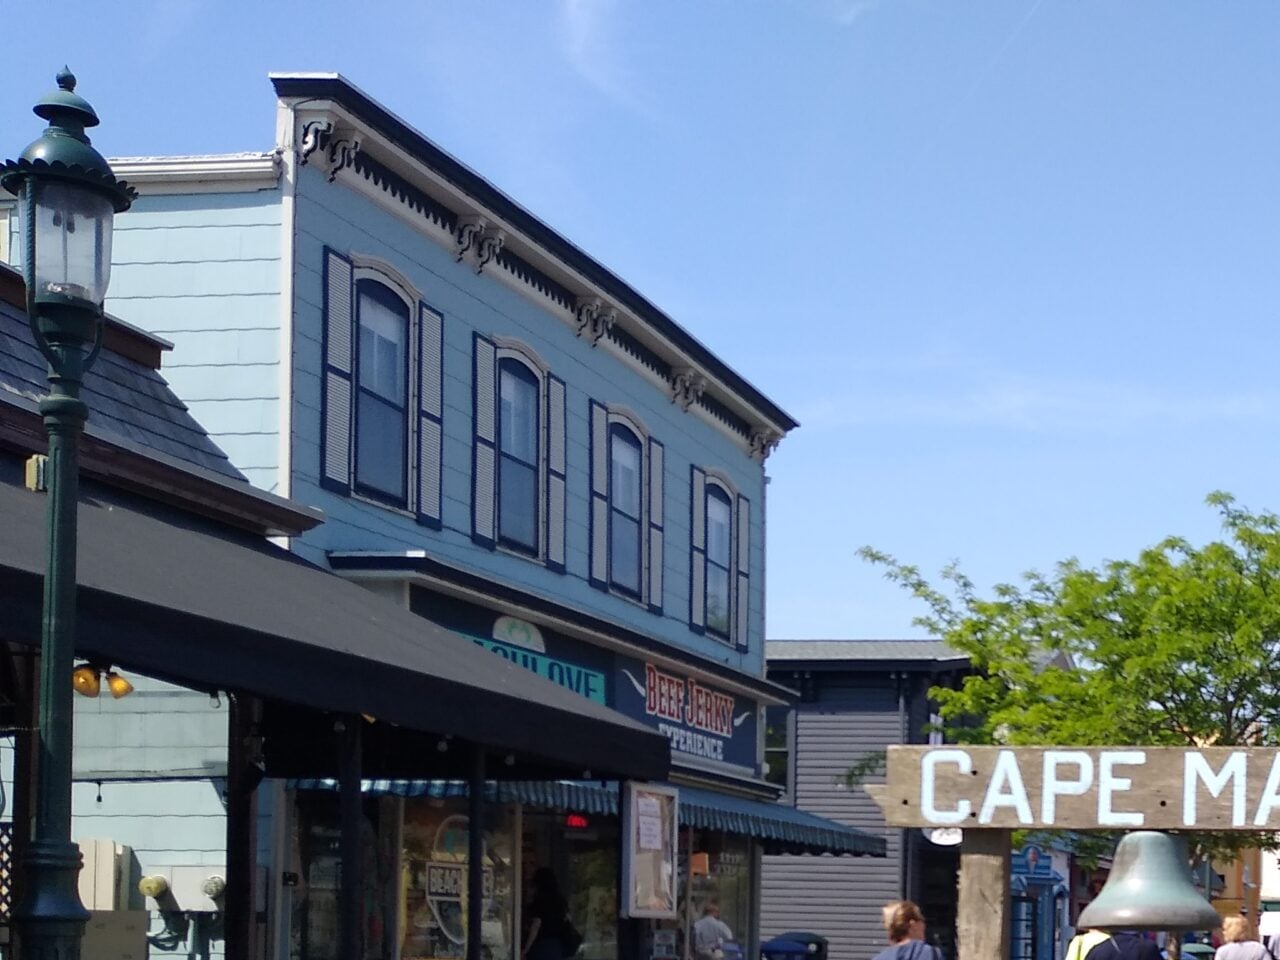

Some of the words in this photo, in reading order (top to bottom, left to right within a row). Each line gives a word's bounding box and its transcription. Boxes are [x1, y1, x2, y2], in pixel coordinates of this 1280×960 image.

[646, 664, 684, 723] BEEF
[686, 679, 734, 738] JERKY
[658, 723, 723, 761] EXPERIENCE
[920, 749, 1146, 825] CAPE
